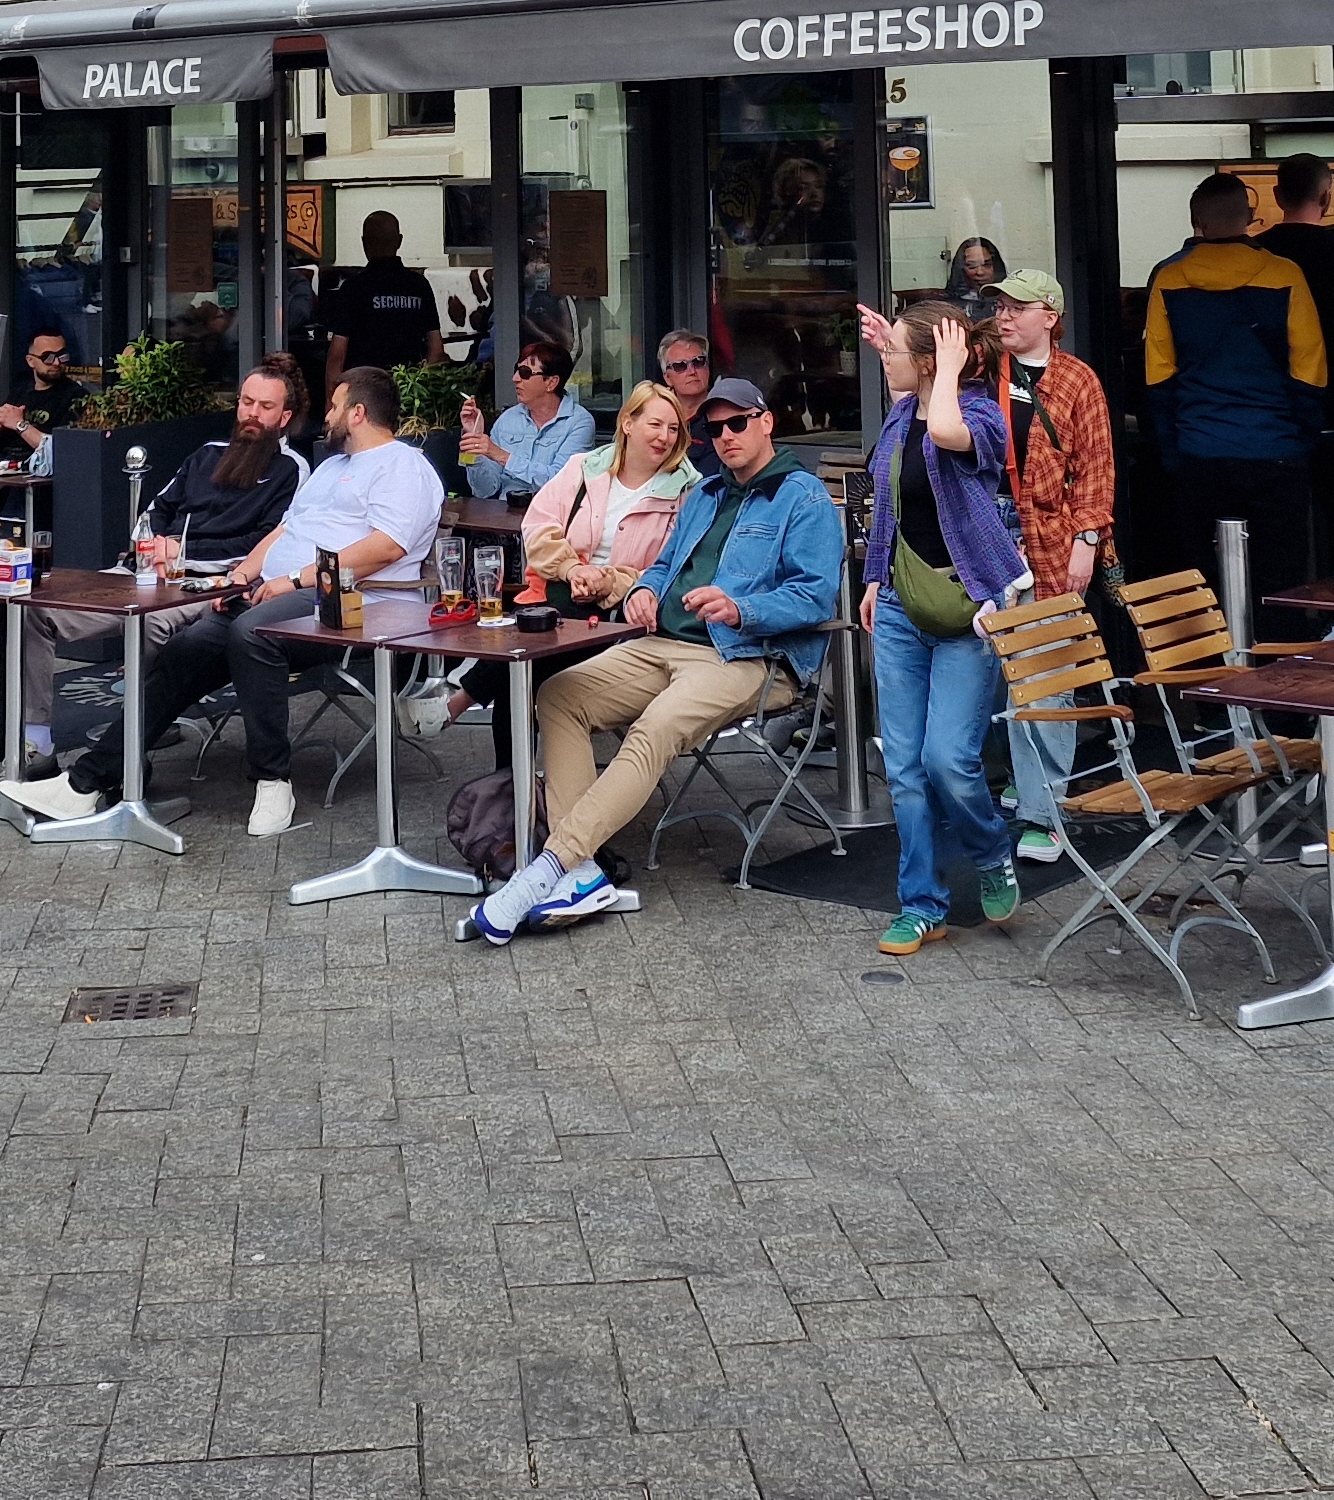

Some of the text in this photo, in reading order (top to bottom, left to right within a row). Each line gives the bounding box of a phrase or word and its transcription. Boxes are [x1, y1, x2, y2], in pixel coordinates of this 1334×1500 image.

[733, 0, 1044, 62] COFFEESHOP
[82, 56, 203, 100] PALACE
[887, 78, 907, 103] 5
[215, 203, 227, 220] &
[373, 296, 422, 309] SECURITY
